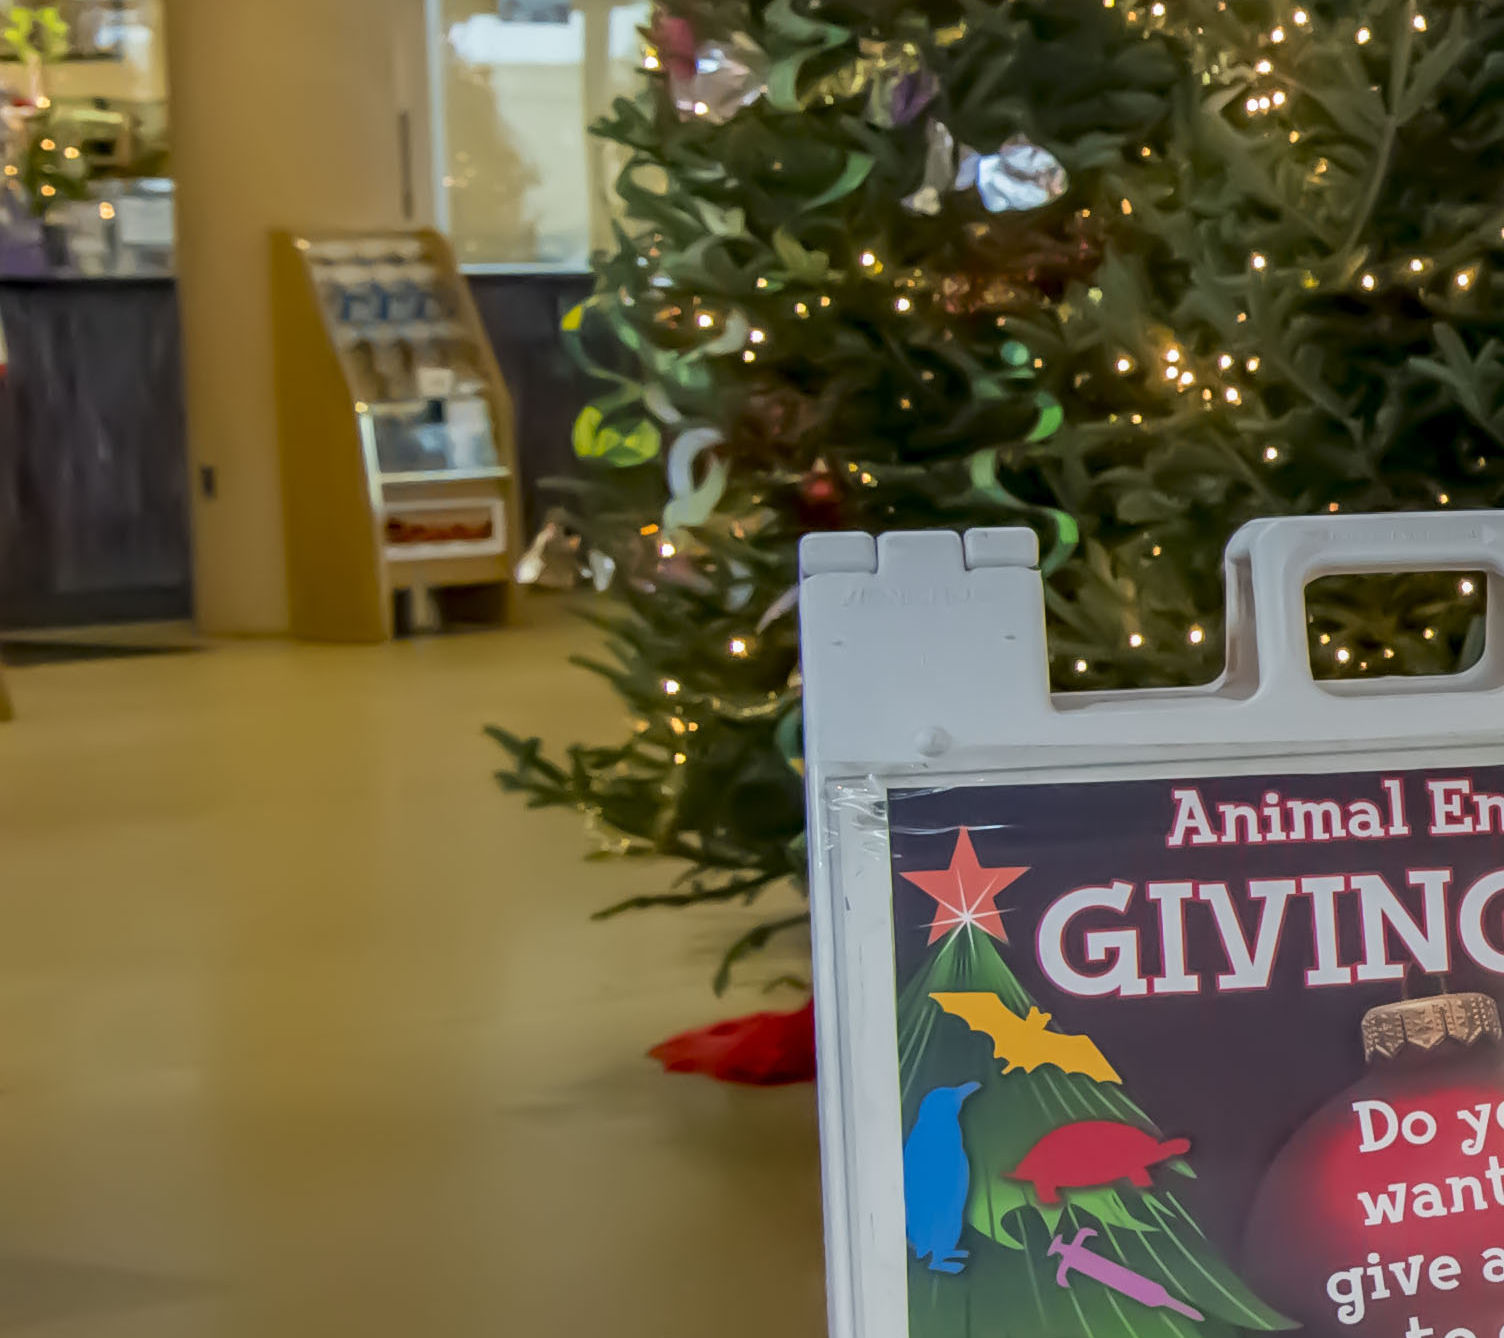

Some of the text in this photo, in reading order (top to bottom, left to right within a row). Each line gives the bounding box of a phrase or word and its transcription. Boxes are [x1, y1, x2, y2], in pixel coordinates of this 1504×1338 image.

[1168, 779, 1409, 846] Animal
[1351, 1099, 1437, 1153] Do
[1326, 1252, 1462, 1325] give
